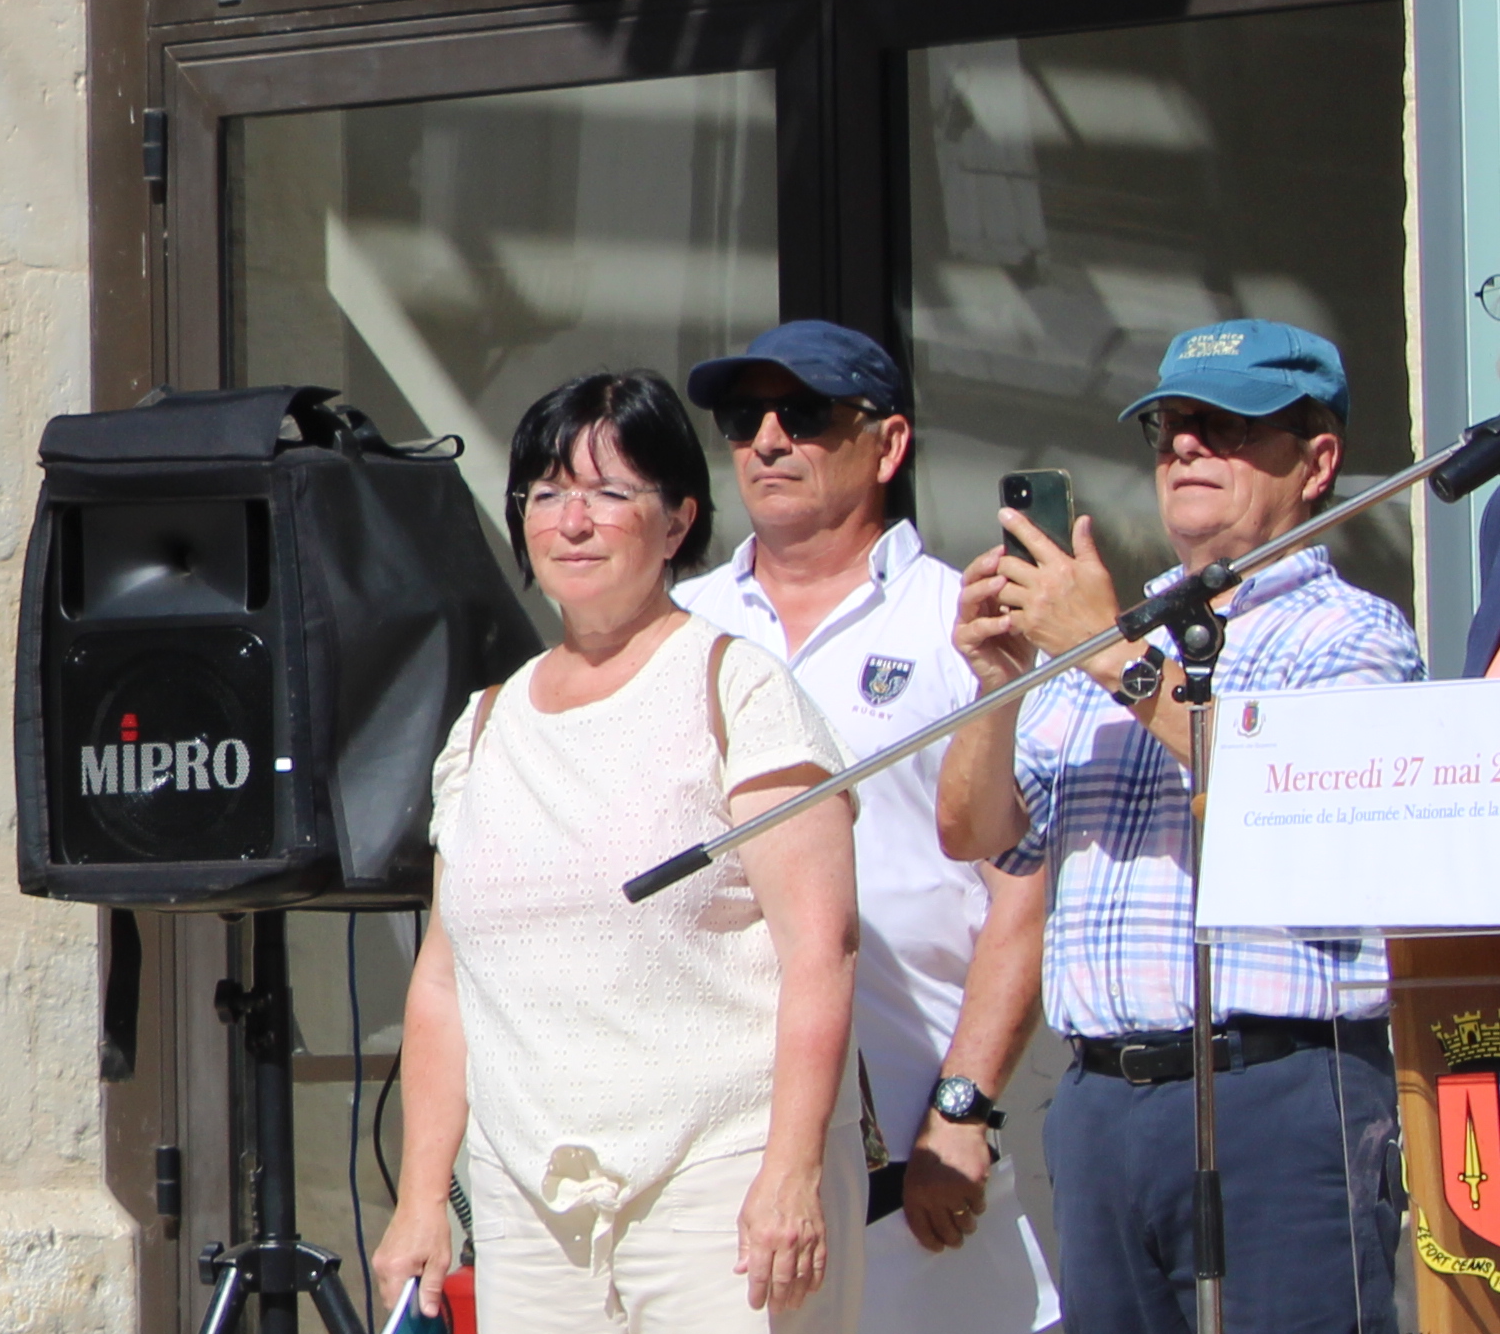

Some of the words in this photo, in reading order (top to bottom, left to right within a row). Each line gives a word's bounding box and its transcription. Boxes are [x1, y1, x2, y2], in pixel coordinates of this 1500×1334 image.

[852, 705, 893, 721] RUGBY
[1264, 757, 1383, 793] Mercredi
[1392, 756, 1424, 788] 27
[1433, 753, 1481, 786] mai
[1243, 809, 1313, 827] Cérémonie
[1316, 808, 1333, 824] de
[1336, 807, 1347, 823] la
[1347, 806, 1399, 825] Journée
[1403, 801, 1465, 820] Nationale
[1468, 801, 1485, 818] de
[1488, 800, 1499, 817] la
[1420, 1242, 1452, 1266] FORT
